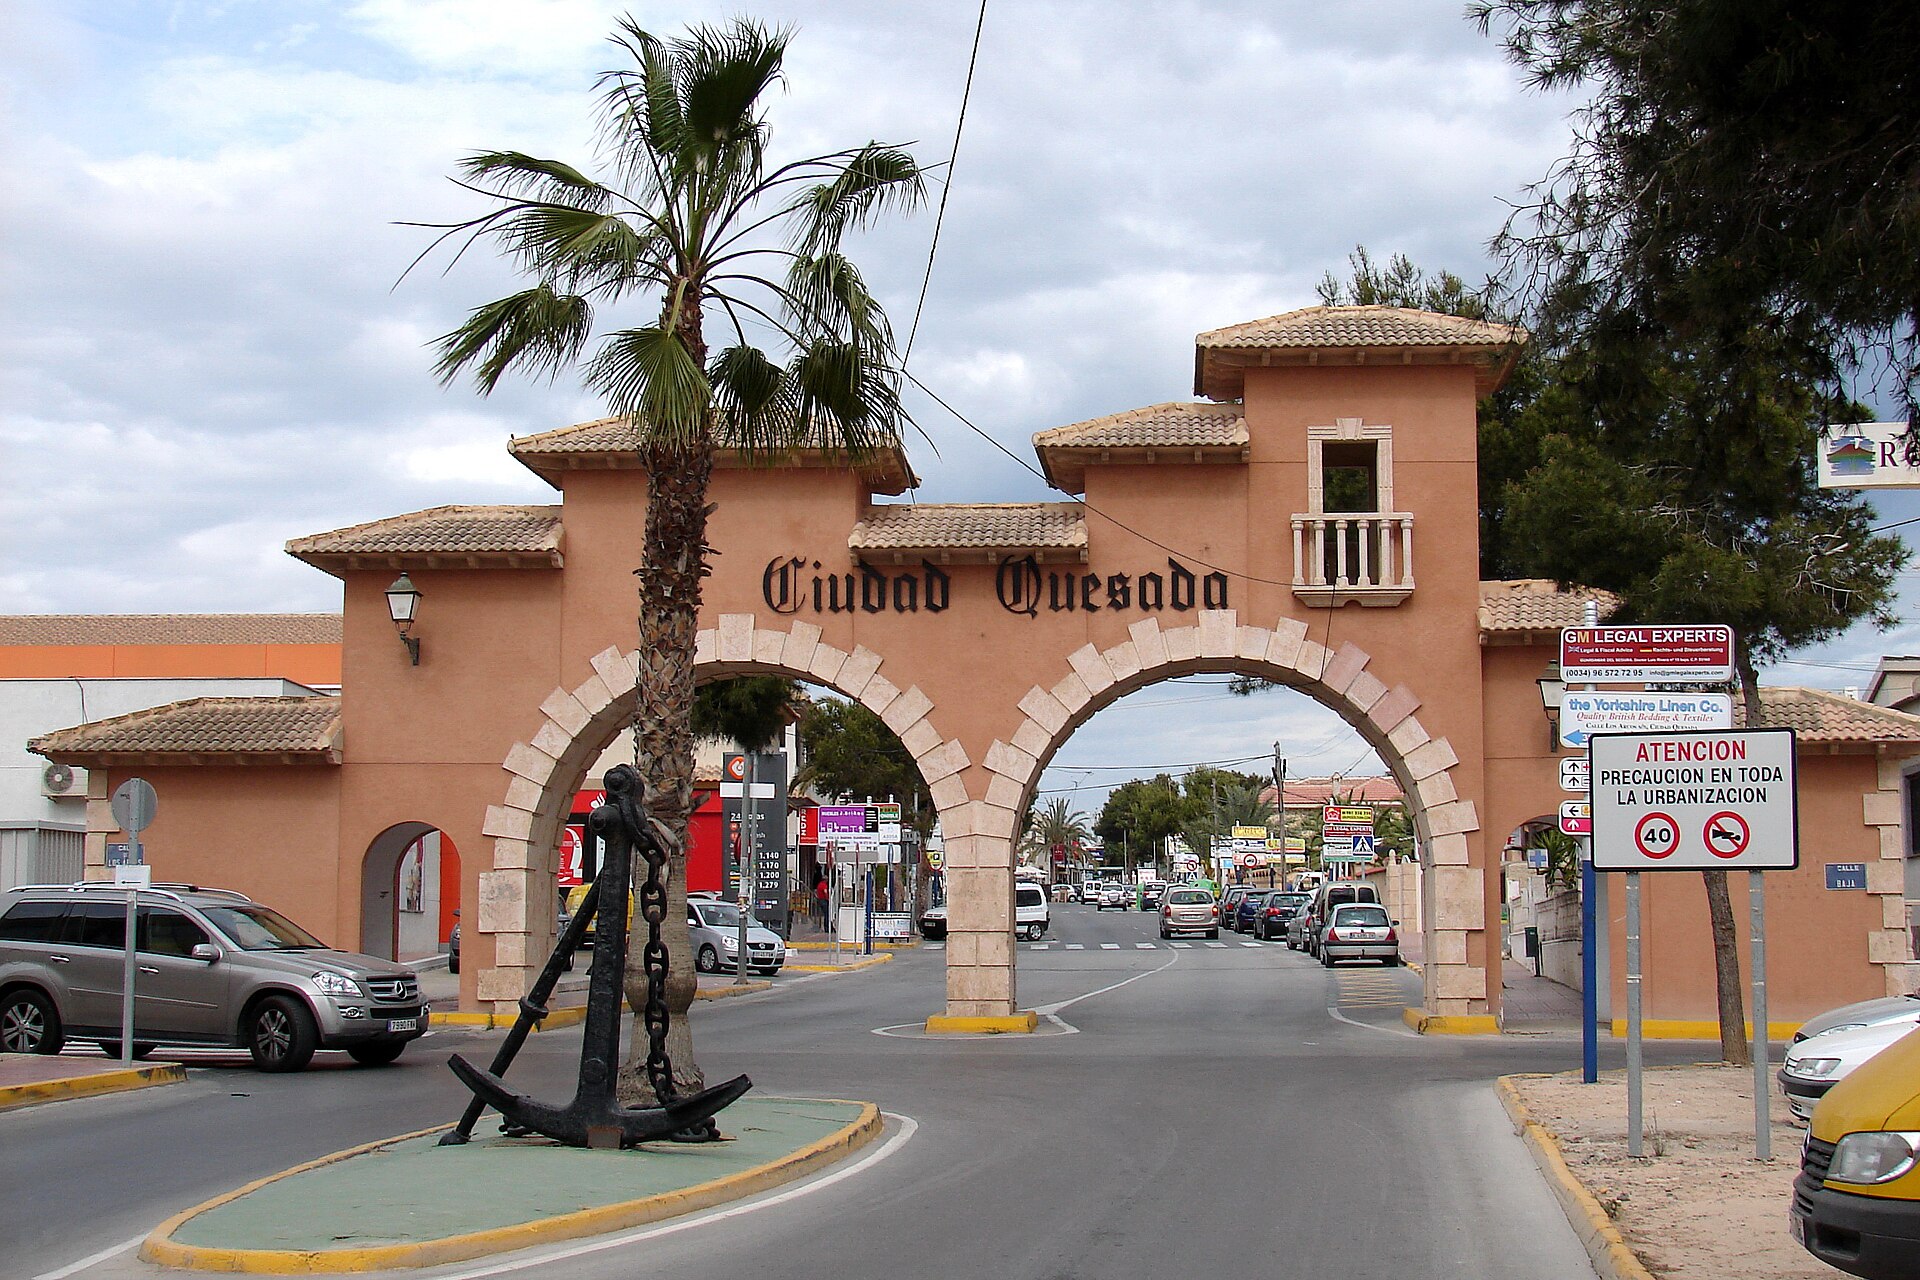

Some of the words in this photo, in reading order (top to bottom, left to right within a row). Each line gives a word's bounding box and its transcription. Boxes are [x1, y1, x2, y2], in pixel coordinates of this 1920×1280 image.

[762, 556, 950, 614] Ciudad
[996, 554, 1228, 619] Quesada
[1564, 630, 1590, 643] GM
[1594, 630, 1648, 643] LEGAL
[1652, 629, 1727, 642] EXPERTS
[1566, 669, 1591, 678] (0034)
[1604, 669, 1619, 677] 572
[1621, 669, 1631, 677] 72
[1569, 699, 1591, 711] the
[1593, 699, 1656, 711] Yorkshire
[1660, 699, 1696, 712] Linen
[1700, 700, 1723, 713] Co.
[1576, 712, 1606, 721] Quality
[1608, 713, 1635, 721] British
[1637, 713, 1670, 722] Bedding
[1672, 713, 1679, 722] &
[1682, 713, 1714, 722] Textiles
[1636, 740, 1746, 762] ATENCION
[1601, 769, 1704, 785] PRECAUCION
[1711, 768, 1732, 783] EN
[1738, 766, 1783, 782] TODA
[1617, 790, 1637, 805] LA
[1644, 787, 1767, 805] URBANIZACION
[1644, 828, 1671, 843] 40
[759, 851, 779, 859] 1.140
[759, 861, 779, 869] 1.170
[759, 871, 780, 879] 1.200
[759, 881, 779, 889] 1.279
[1836, 879, 1856, 887] BAJA
